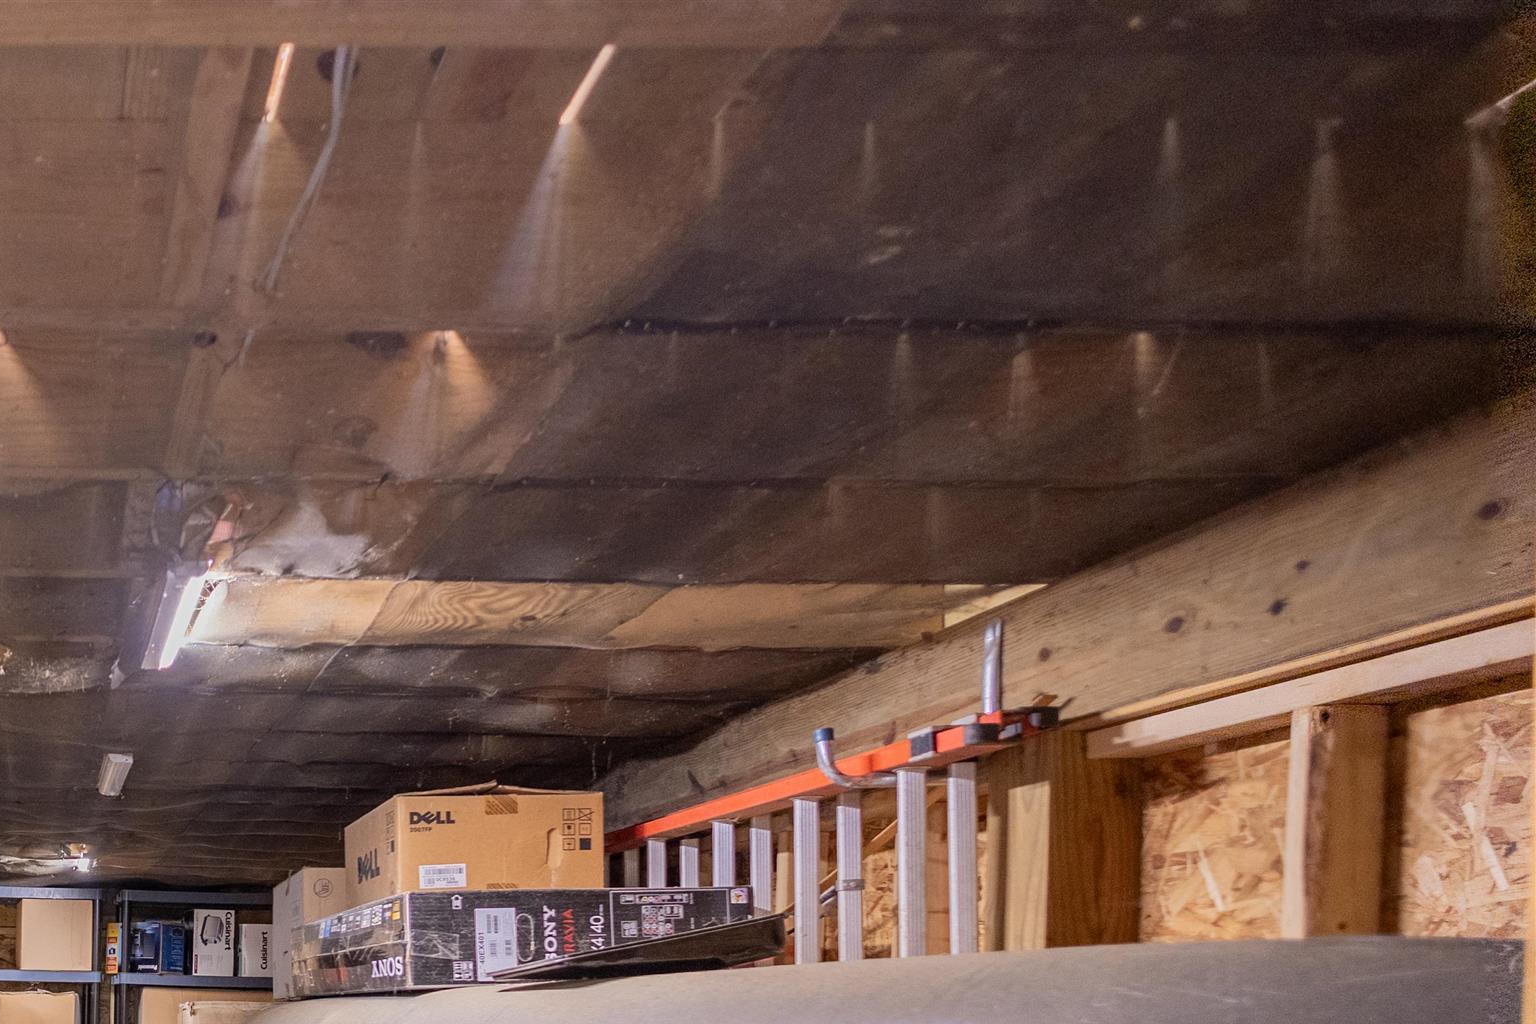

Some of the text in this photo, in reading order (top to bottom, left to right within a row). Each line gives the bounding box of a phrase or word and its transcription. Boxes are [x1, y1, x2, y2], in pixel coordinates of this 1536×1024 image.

[409, 811, 456, 825] DELL
[357, 848, 380, 884] DELL
[225, 911, 233, 951] Cuisinart
[562, 907, 575, 953] RAVIA
[260, 931, 268, 970] Cuisinart
[371, 956, 404, 978] SONY
